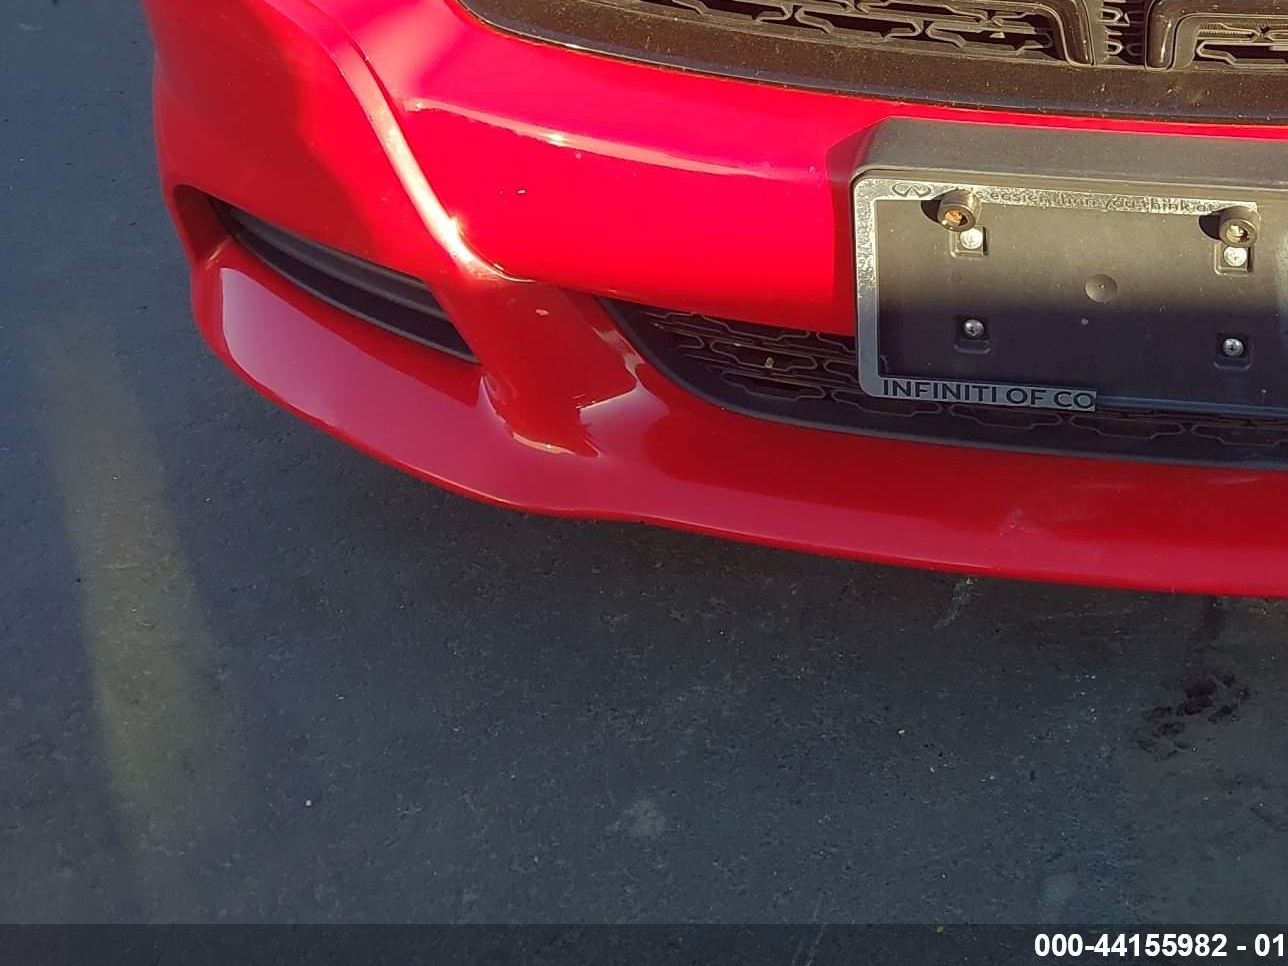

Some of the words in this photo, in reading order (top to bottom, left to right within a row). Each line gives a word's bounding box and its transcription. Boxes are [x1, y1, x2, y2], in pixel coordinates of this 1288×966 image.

[1100, 197, 1137, 212] you
[1142, 197, 1190, 211] think
[882, 380, 998, 402] INFINITI
[1005, 387, 1047, 406] OF
[1053, 390, 1096, 409] CO
